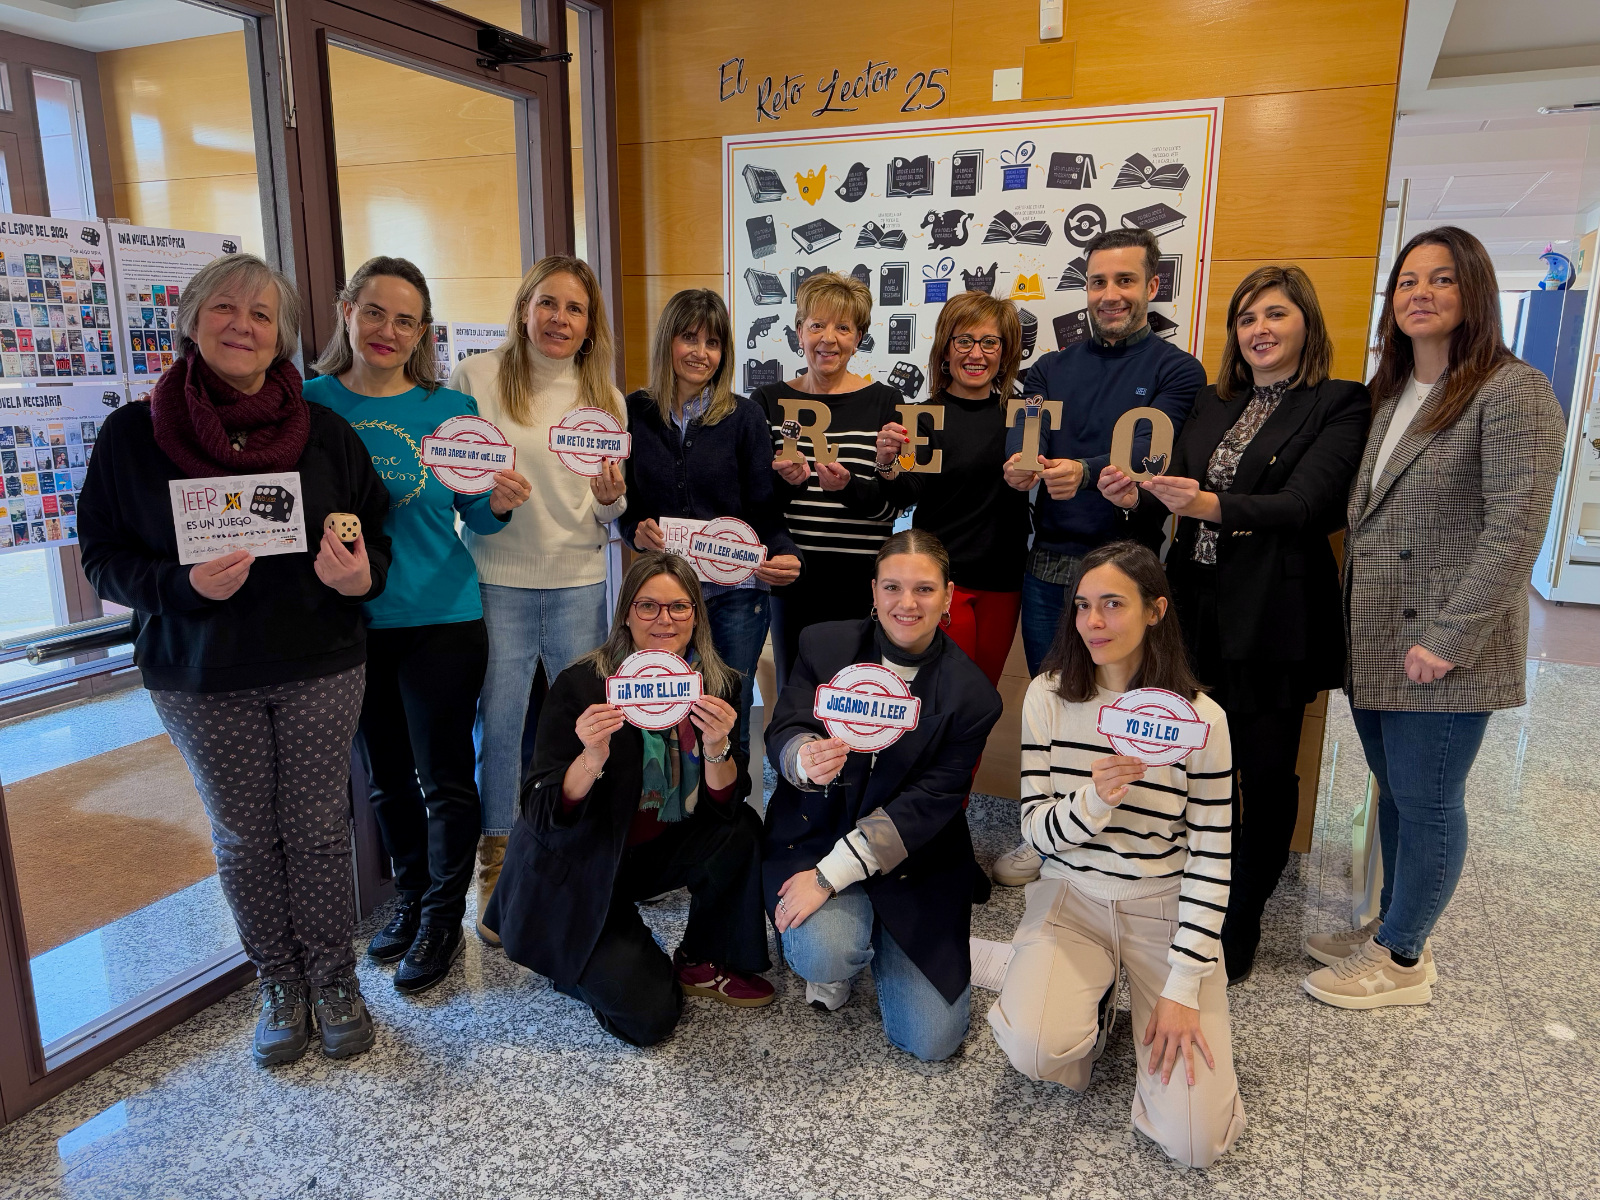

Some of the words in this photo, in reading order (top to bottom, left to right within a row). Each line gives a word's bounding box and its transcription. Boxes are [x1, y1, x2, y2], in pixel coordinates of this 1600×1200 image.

[718, 57, 748, 103] El
[755, 74, 806, 123] Reto
[811, 59, 898, 118] Lector
[900, 68, 949, 113] 25
[35, 224, 50, 237] DEL
[50, 226, 68, 239] 2024
[118, 233, 131, 244] UNA
[132, 234, 155, 246] NOVELA
[23, 395, 62, 408] NECESARIA
[557, 434, 565, 444] UN
[567, 435, 584, 447] RETO
[586, 437, 594, 448] SE
[596, 438, 621, 451] SUPERA
[431, 446, 447, 456] PARA
[448, 448, 466, 459] SABER
[468, 450, 479, 460] HAY
[480, 453, 490, 462] QUE
[491, 454, 506, 463] LEER
[182, 488, 218, 514] LEER
[187, 521, 197, 530] ES
[199, 517, 215, 530] UN
[218, 516, 252, 529] JUEGO
[665, 525, 689, 543] LEER
[673, 548, 683, 556] UN
[694, 540, 707, 551] VOY
[707, 543, 712, 554] A
[714, 544, 731, 557] LEER
[731, 548, 759, 564] JUGANDO
[618, 683, 632, 700] ¡¡A
[634, 683, 654, 698] POR
[656, 682, 690, 698] ELLO!!
[827, 695, 869, 715] JUGANDO
[870, 701, 878, 717] A
[880, 702, 907, 720] LEER
[1126, 719, 1140, 734] YO
[1155, 724, 1179, 741] LEO
